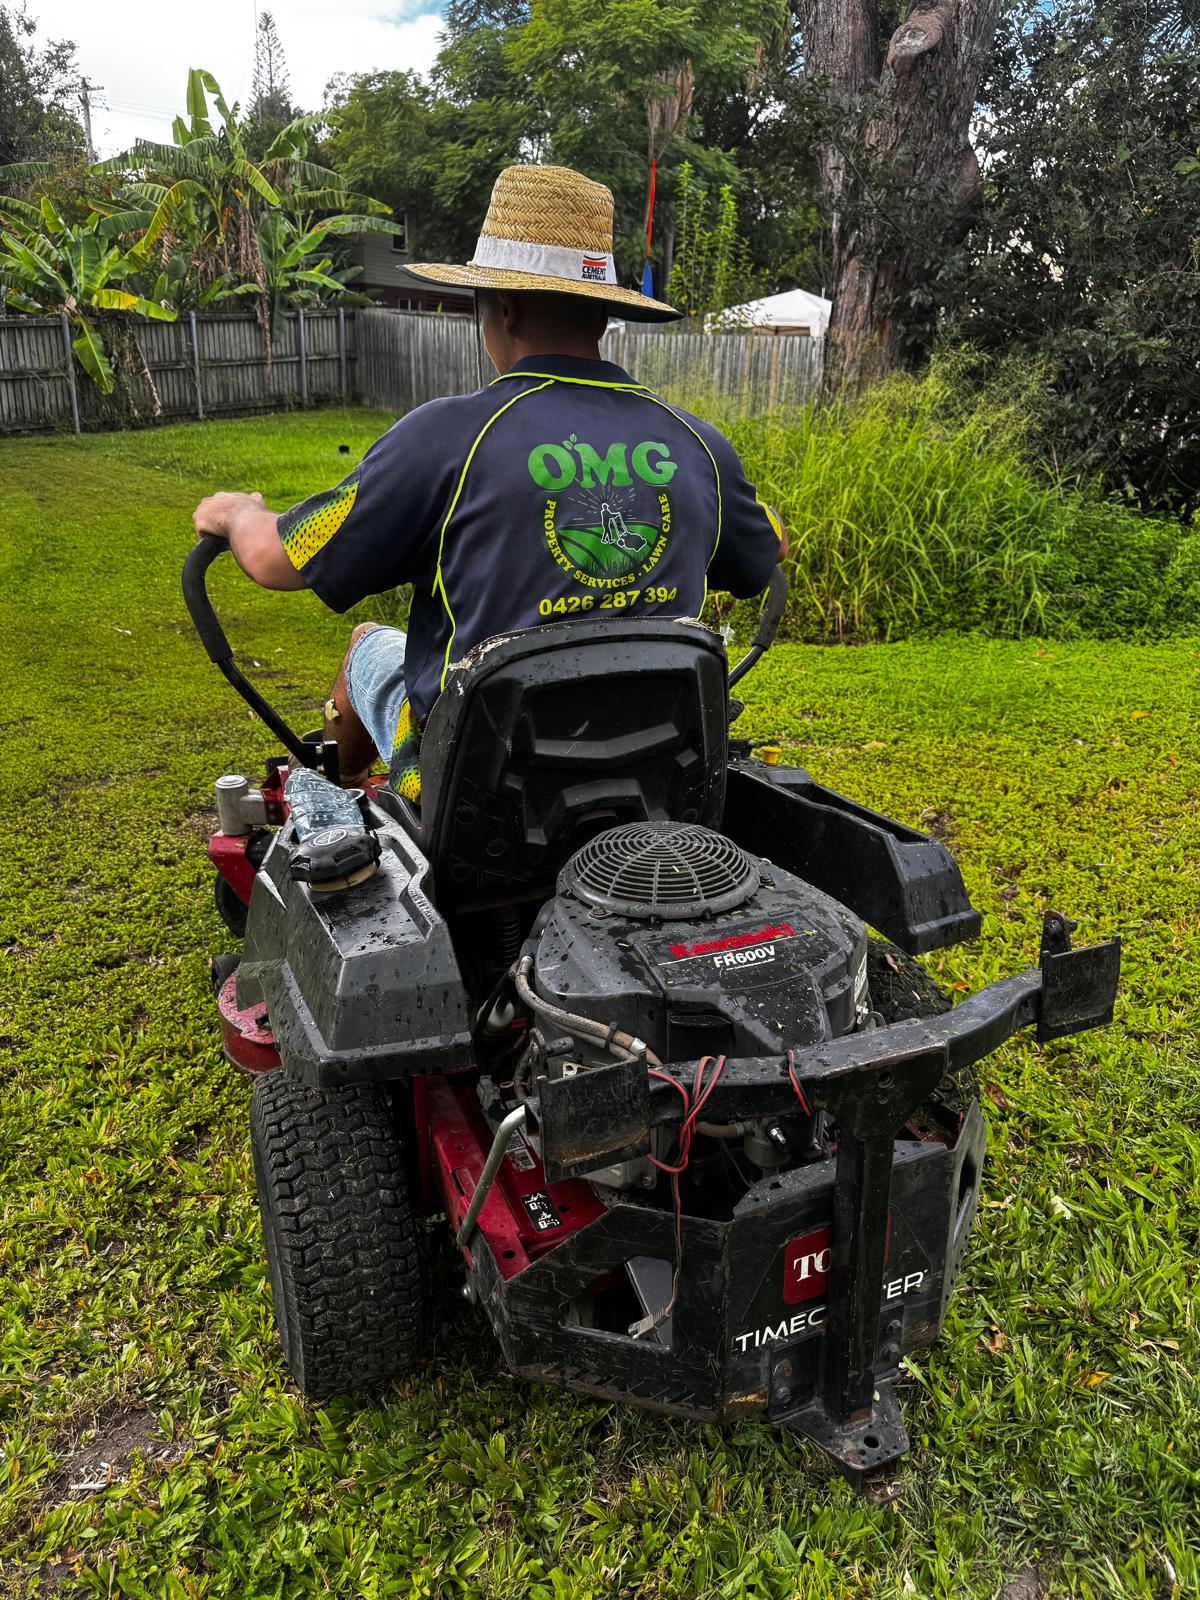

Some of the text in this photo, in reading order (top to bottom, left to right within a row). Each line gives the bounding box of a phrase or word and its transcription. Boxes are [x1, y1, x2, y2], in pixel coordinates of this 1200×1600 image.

[582, 266, 606, 275] CEMENT
[527, 440, 678, 491] OMG
[543, 493, 672, 590] PROPERTY SERVICES LAWN CARE
[538, 586, 678, 617] 0426 287 394
[666, 921, 796, 960] Kawasaki
[713, 945, 776, 968] FR600V
[793, 1247, 832, 1283] TO
